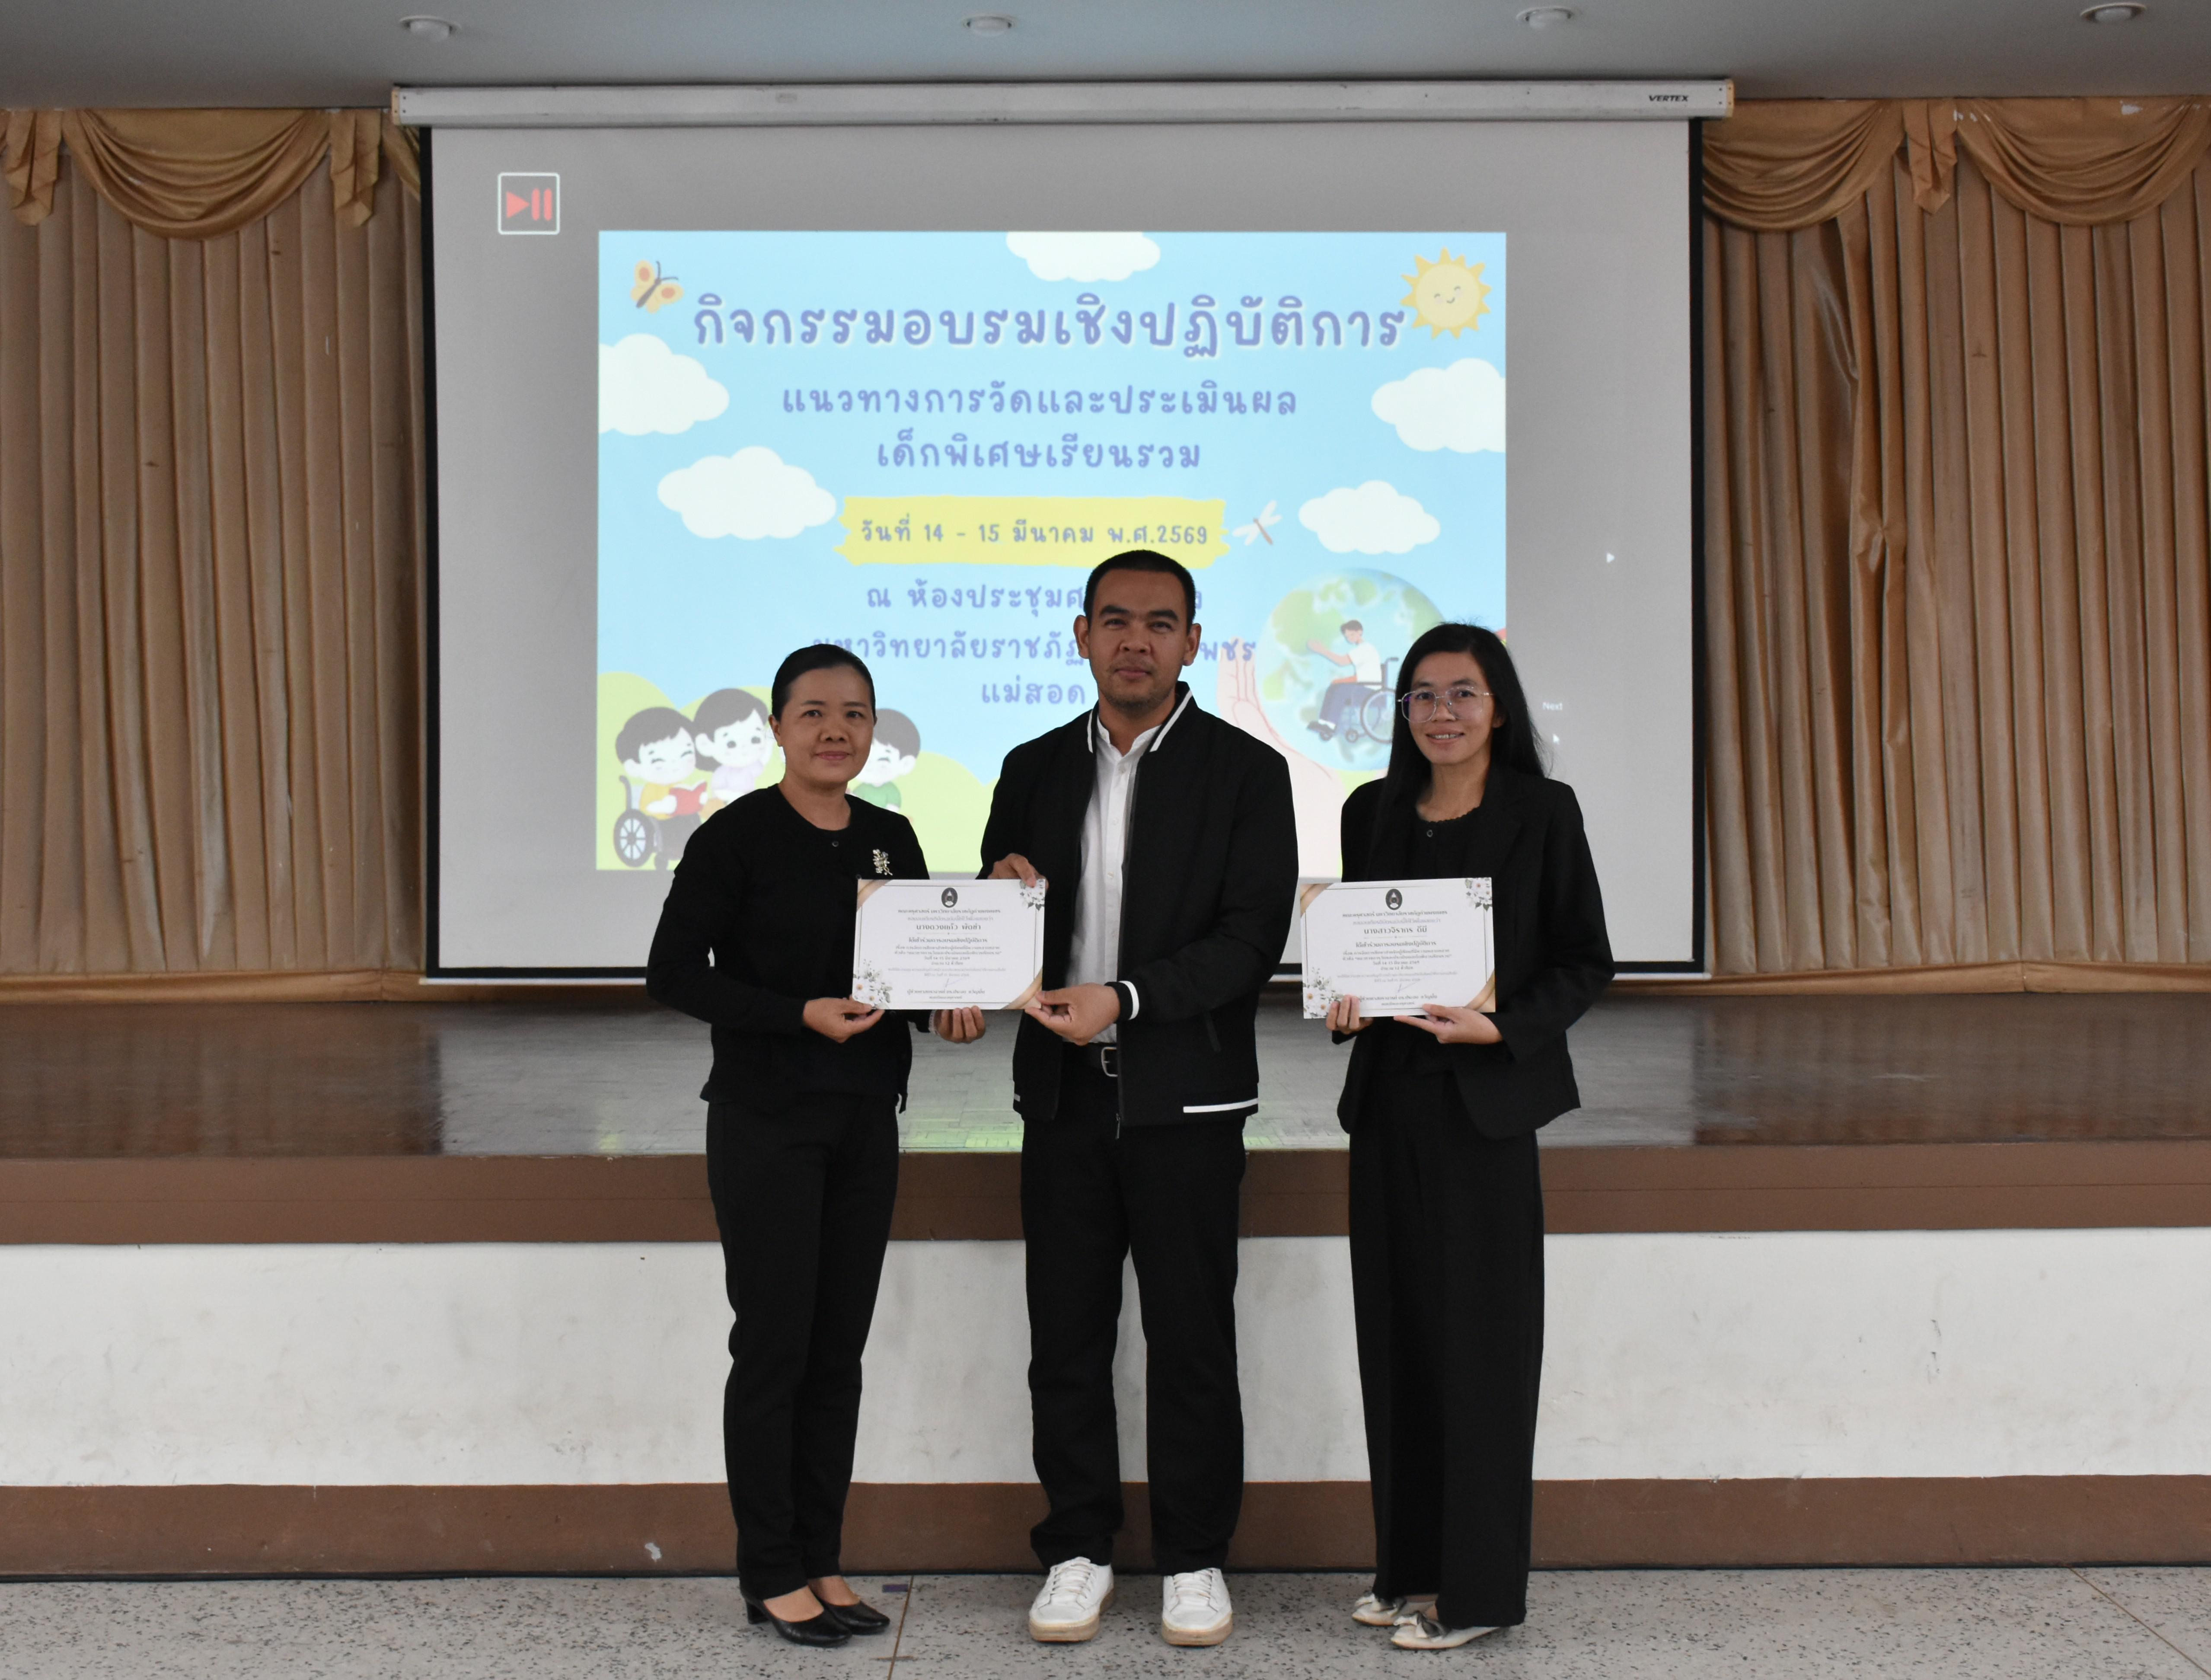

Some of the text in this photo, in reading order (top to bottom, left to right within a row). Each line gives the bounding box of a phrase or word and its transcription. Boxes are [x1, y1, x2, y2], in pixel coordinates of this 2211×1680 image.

[693, 292, 1406, 358] กิจกรรมอบรมเชิงปฏิบัติการ
[783, 380, 1296, 415] แนวทางการวัดและประเมินผล
[877, 427, 1200, 468] เด็กพิเศษเรียนรวม
[861, 514, 911, 542] วันที่
[925, 524, 944, 541] 14
[979, 524, 1000, 542] 15
[1013, 520, 1094, 543] มีนาคม
[1107, 524, 1207, 545] พ.ศ.2569
[867, 588, 891, 608] ณ
[982, 675, 1085, 705] แม่สอด
[1542, 702, 1563, 710] Next
